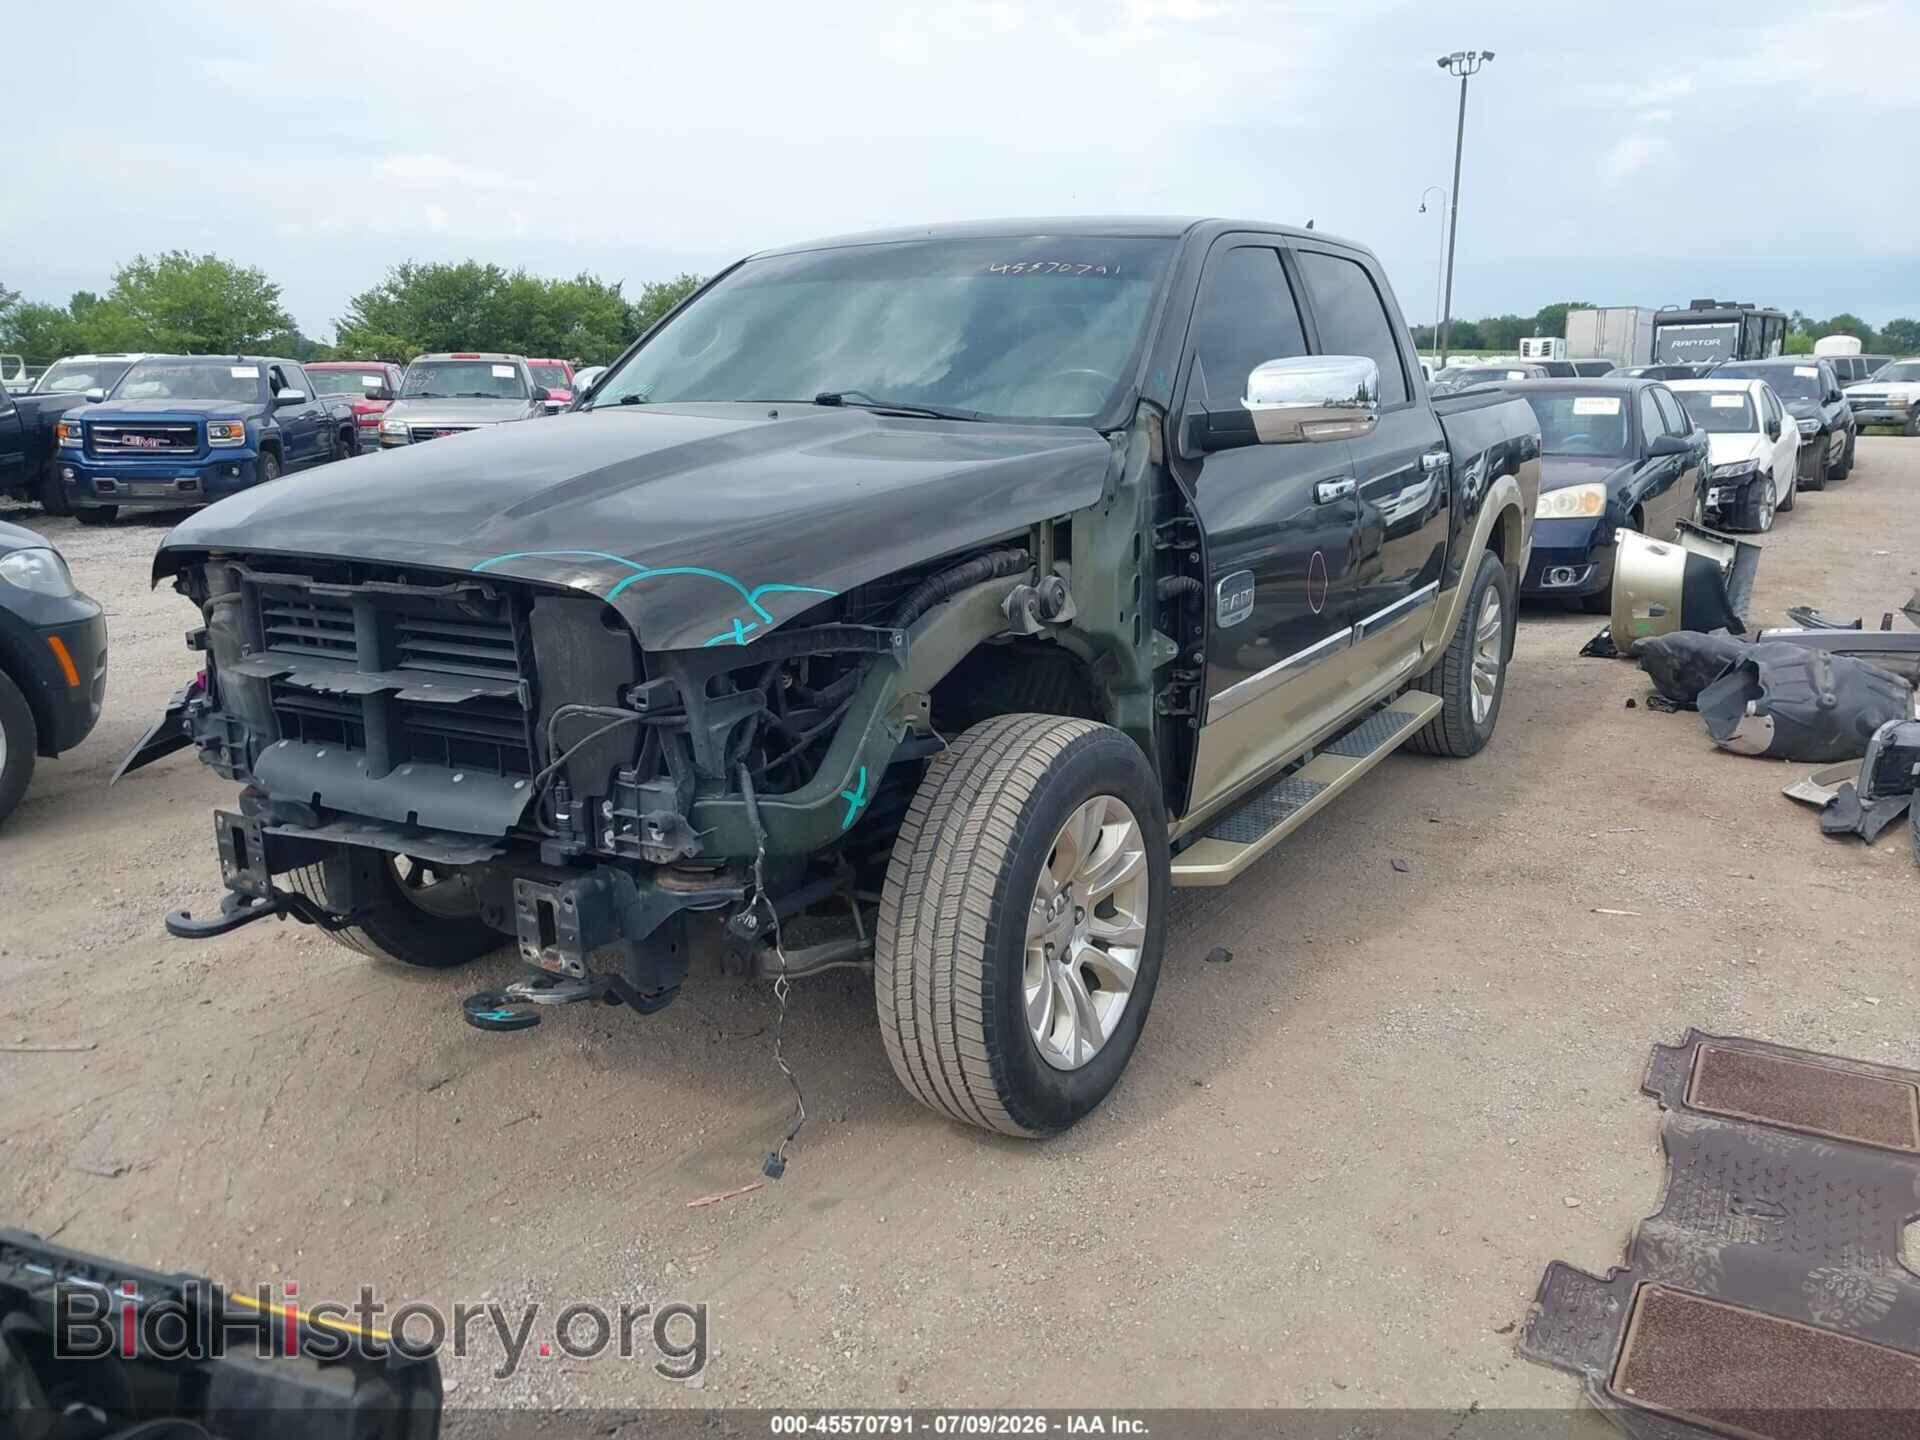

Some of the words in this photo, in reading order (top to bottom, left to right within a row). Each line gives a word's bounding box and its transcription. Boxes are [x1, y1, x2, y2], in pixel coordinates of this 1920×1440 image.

[989, 261, 1120, 275] 45570791
[1671, 338, 1721, 348] RAPTOR
[122, 434, 160, 448] GMC
